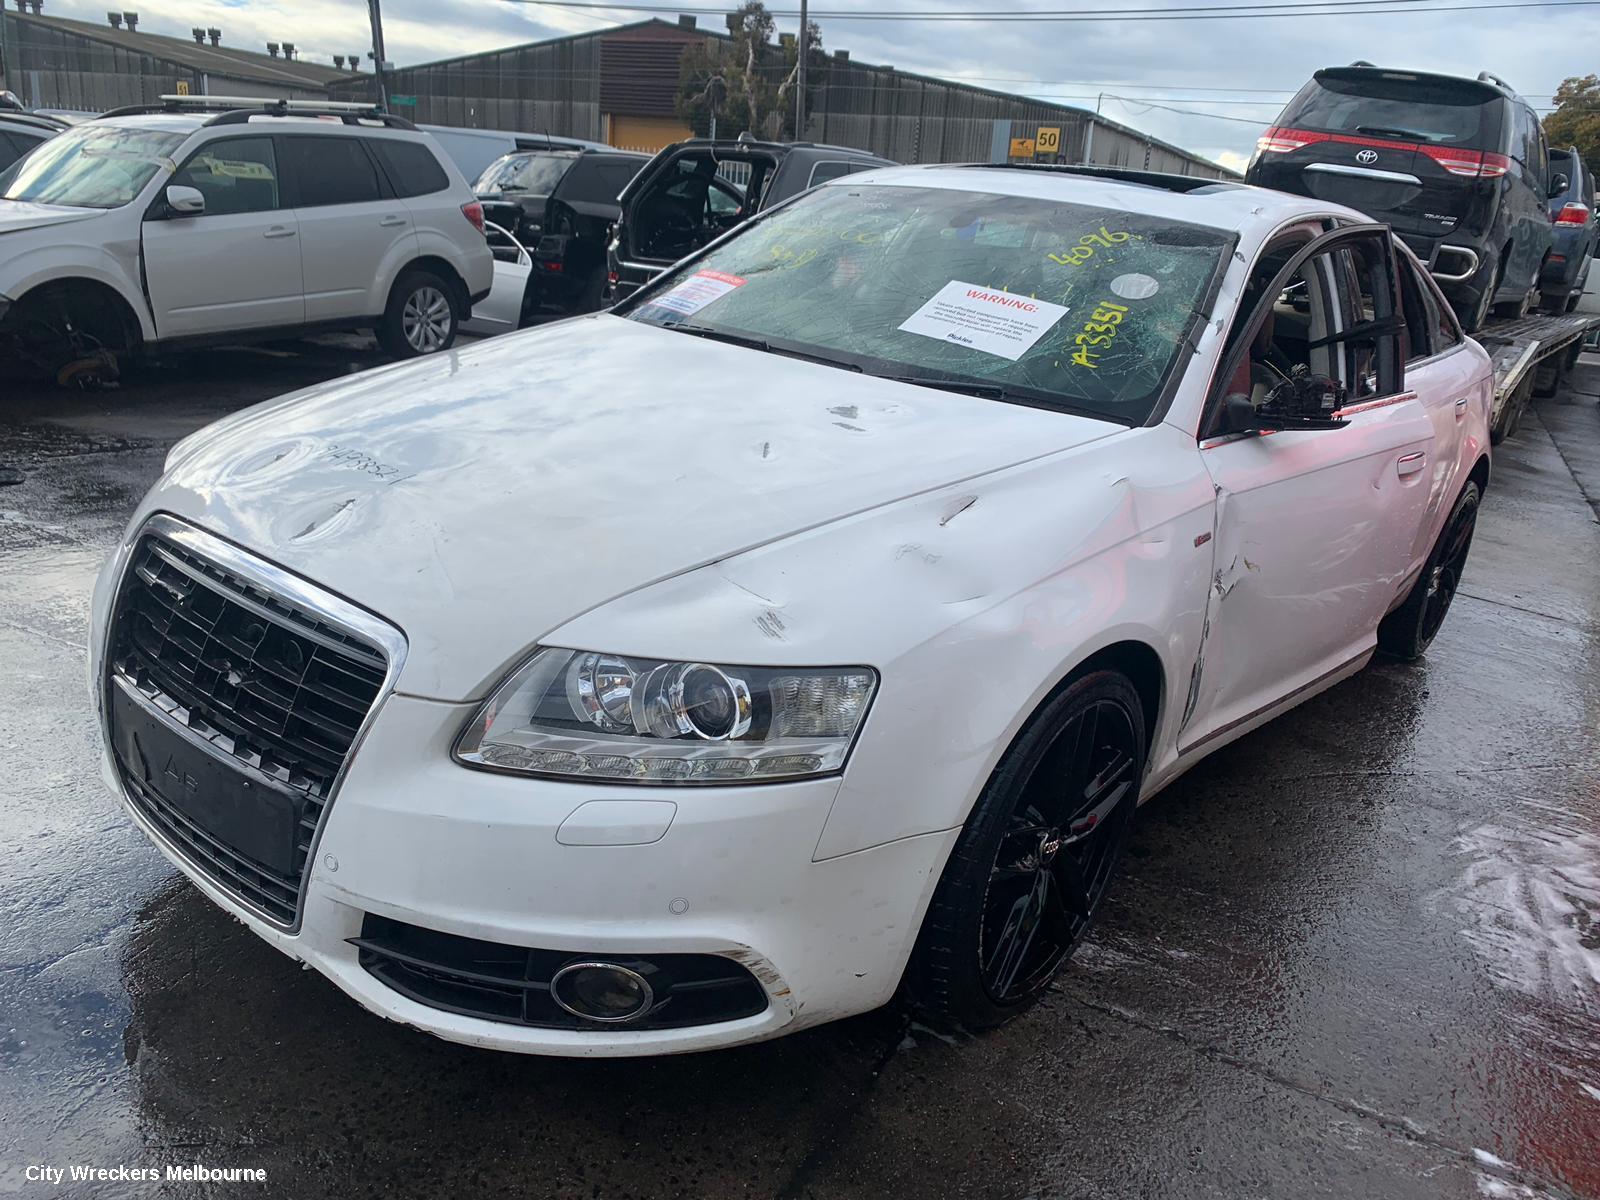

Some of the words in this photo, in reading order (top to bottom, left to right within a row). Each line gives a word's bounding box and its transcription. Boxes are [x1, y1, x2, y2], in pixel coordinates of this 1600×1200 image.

[1039, 132, 1057, 146] 50
[1047, 226, 1130, 266] 4096
[966, 289, 1039, 313] WARNING:
[947, 333, 973, 344] Pickles
